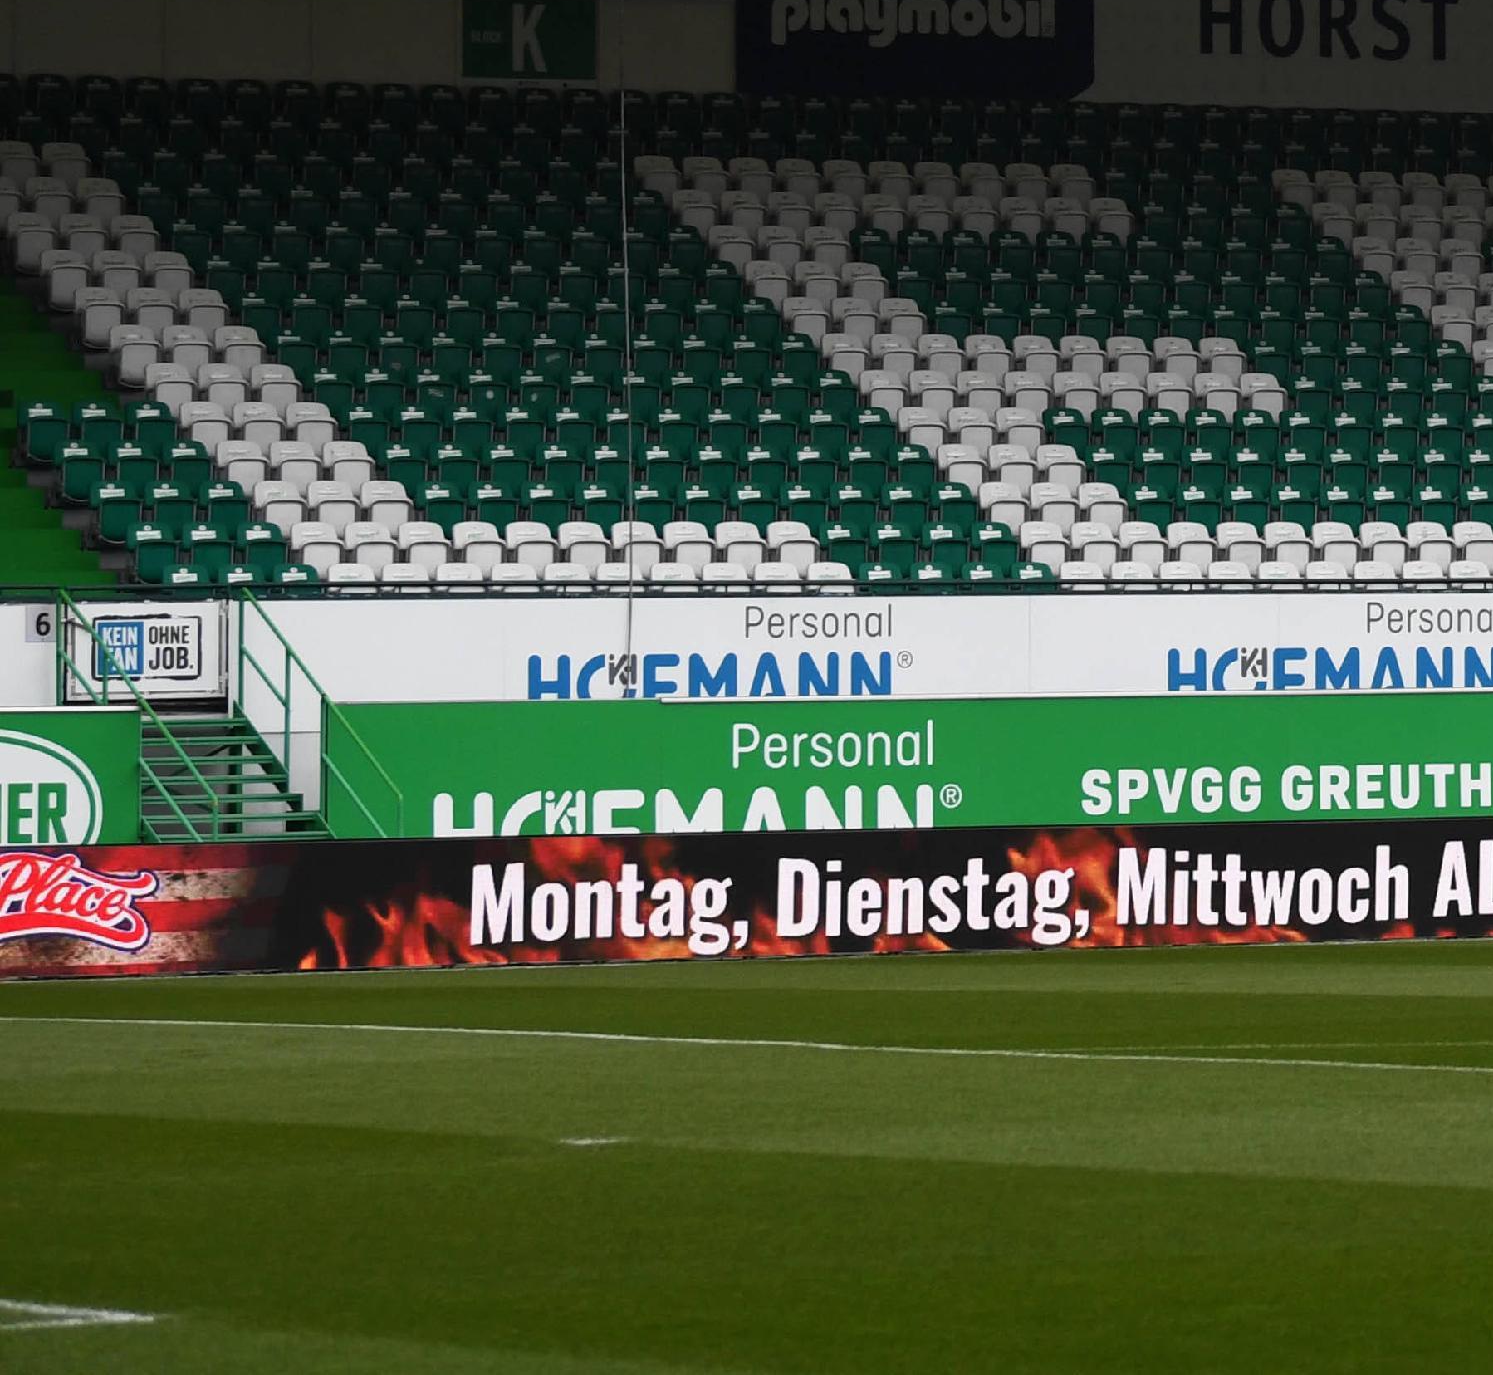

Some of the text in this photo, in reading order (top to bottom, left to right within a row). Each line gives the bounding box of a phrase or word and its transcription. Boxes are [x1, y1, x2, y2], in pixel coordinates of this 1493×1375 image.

[511, 2, 548, 73] K
[36, 612, 51, 636] 6
[101, 626, 138, 646] KEIN
[148, 625, 190, 645] OHNE
[745, 603, 893, 640] Personal
[148, 646, 195, 671] JOB.
[731, 718, 935, 770] Personal
[1079, 765, 1262, 816] SPVGG
[0, 782, 69, 844] ER
[469, 859, 749, 956] Montag,
[775, 856, 1090, 945] Dienstag,
[1115, 844, 1409, 926] Mittwoch
